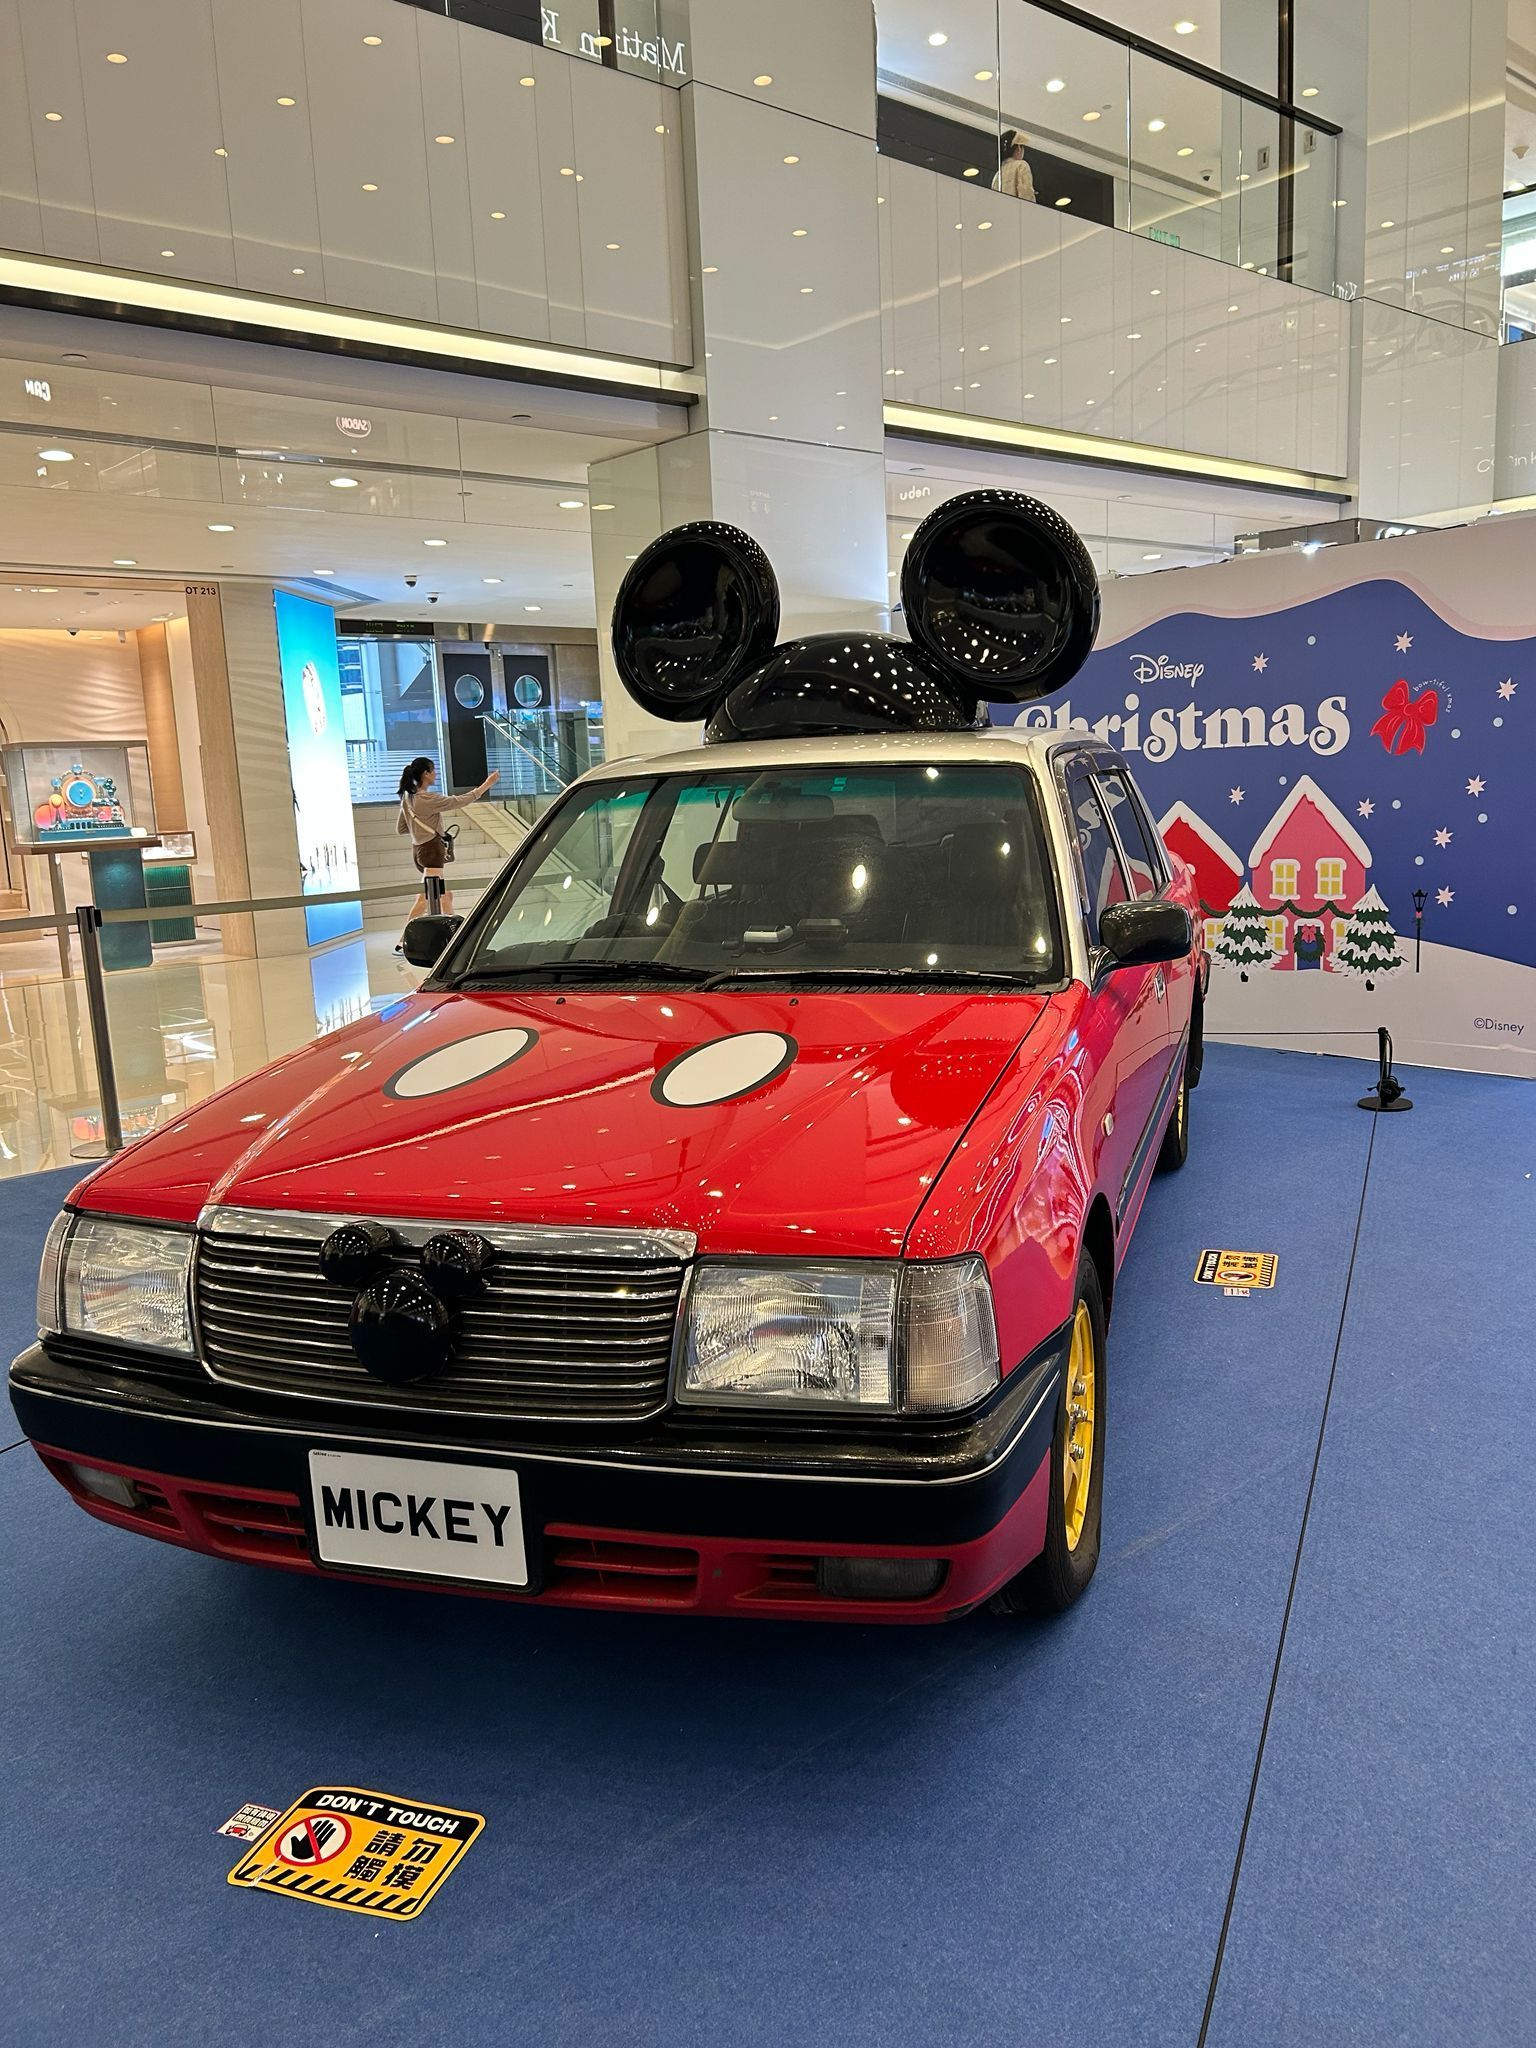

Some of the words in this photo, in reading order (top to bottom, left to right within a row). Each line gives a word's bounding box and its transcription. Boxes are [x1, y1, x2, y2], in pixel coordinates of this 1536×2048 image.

[185, 586, 199, 595] OT
[200, 587, 217, 596] 213
[321, 1485, 511, 1547] MICKEY
[315, 1794, 384, 1816] DON'T
[386, 1807, 460, 1834] TOUCH
[364, 1829, 443, 1864] 請勿
[342, 1854, 425, 1891] 觸摸
